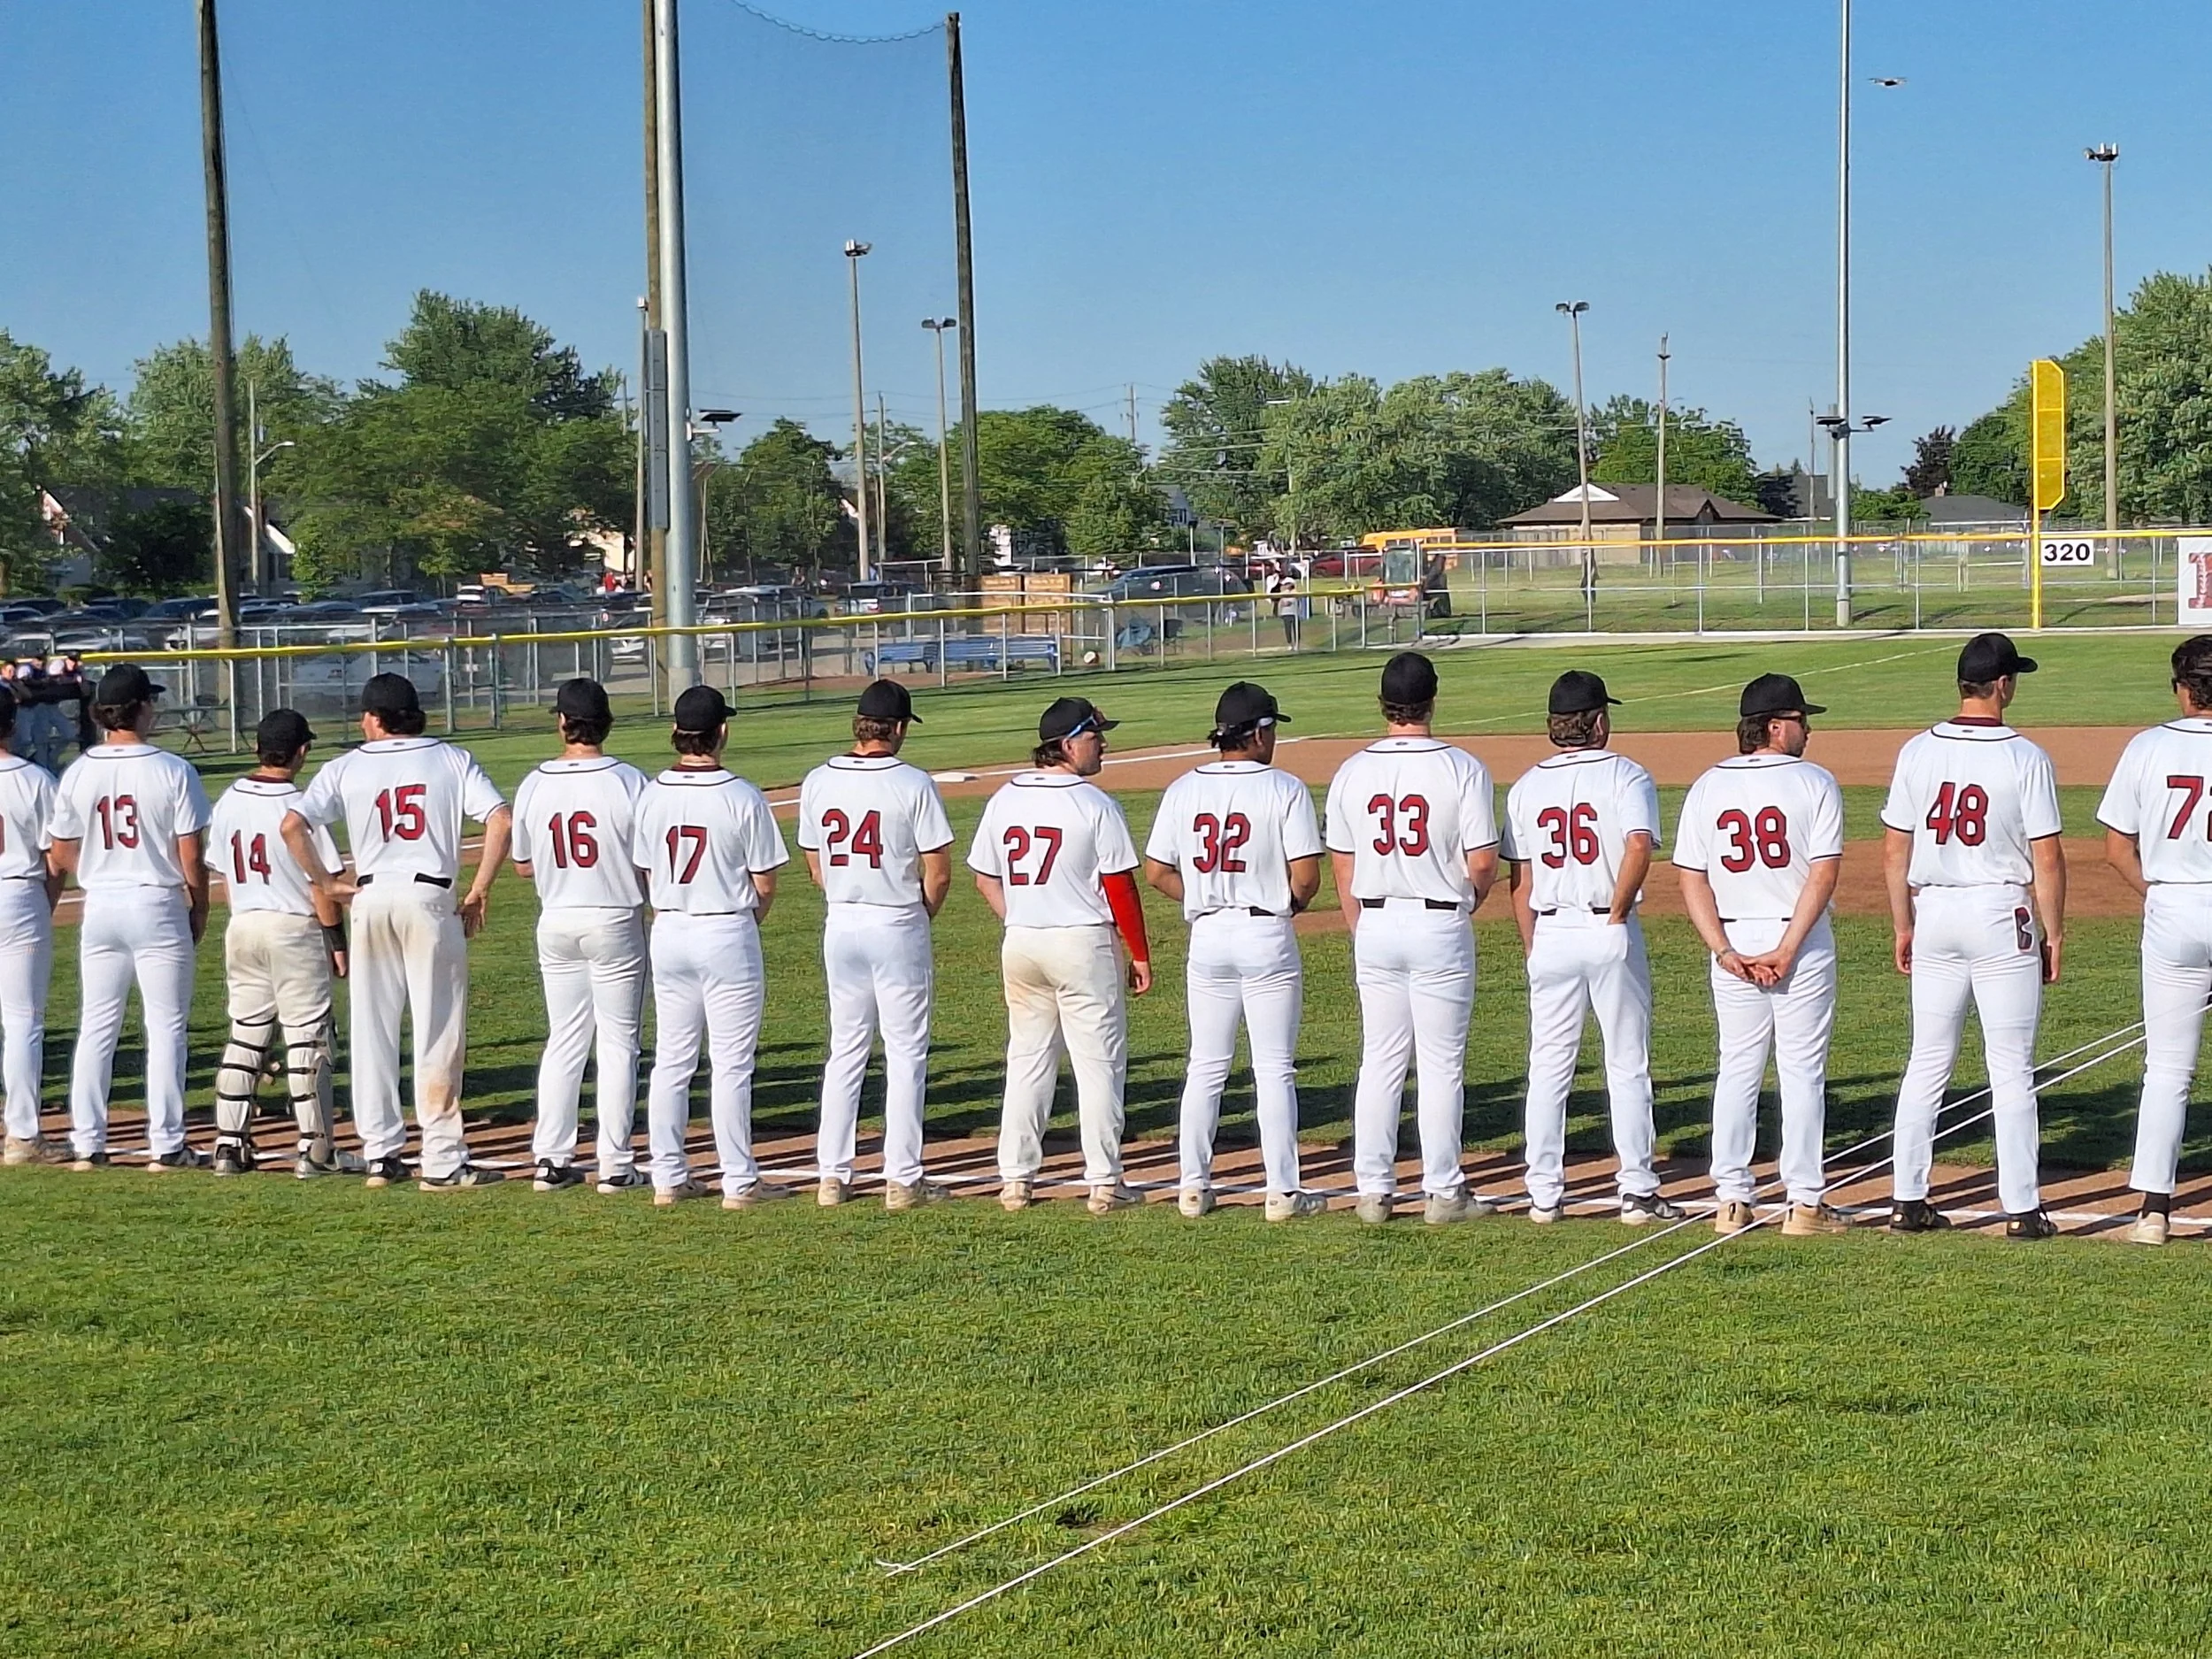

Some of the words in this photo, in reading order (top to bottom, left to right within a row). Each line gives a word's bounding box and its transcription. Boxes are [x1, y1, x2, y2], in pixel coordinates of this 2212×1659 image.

[2044, 543, 2090, 561] 320
[96, 794, 140, 850] 13
[375, 783, 426, 842] 15
[1367, 794, 1430, 856] 33
[1537, 803, 1600, 869] 36
[1925, 781, 1989, 847] 48
[2166, 774, 2212, 841] 7
[230, 829, 273, 885] 14
[548, 810, 599, 870] 16
[665, 825, 708, 885] 17
[821, 809, 884, 870] 24
[1002, 826, 1063, 887] 27
[1193, 812, 1251, 873] 32
[1717, 806, 1791, 873] 38
